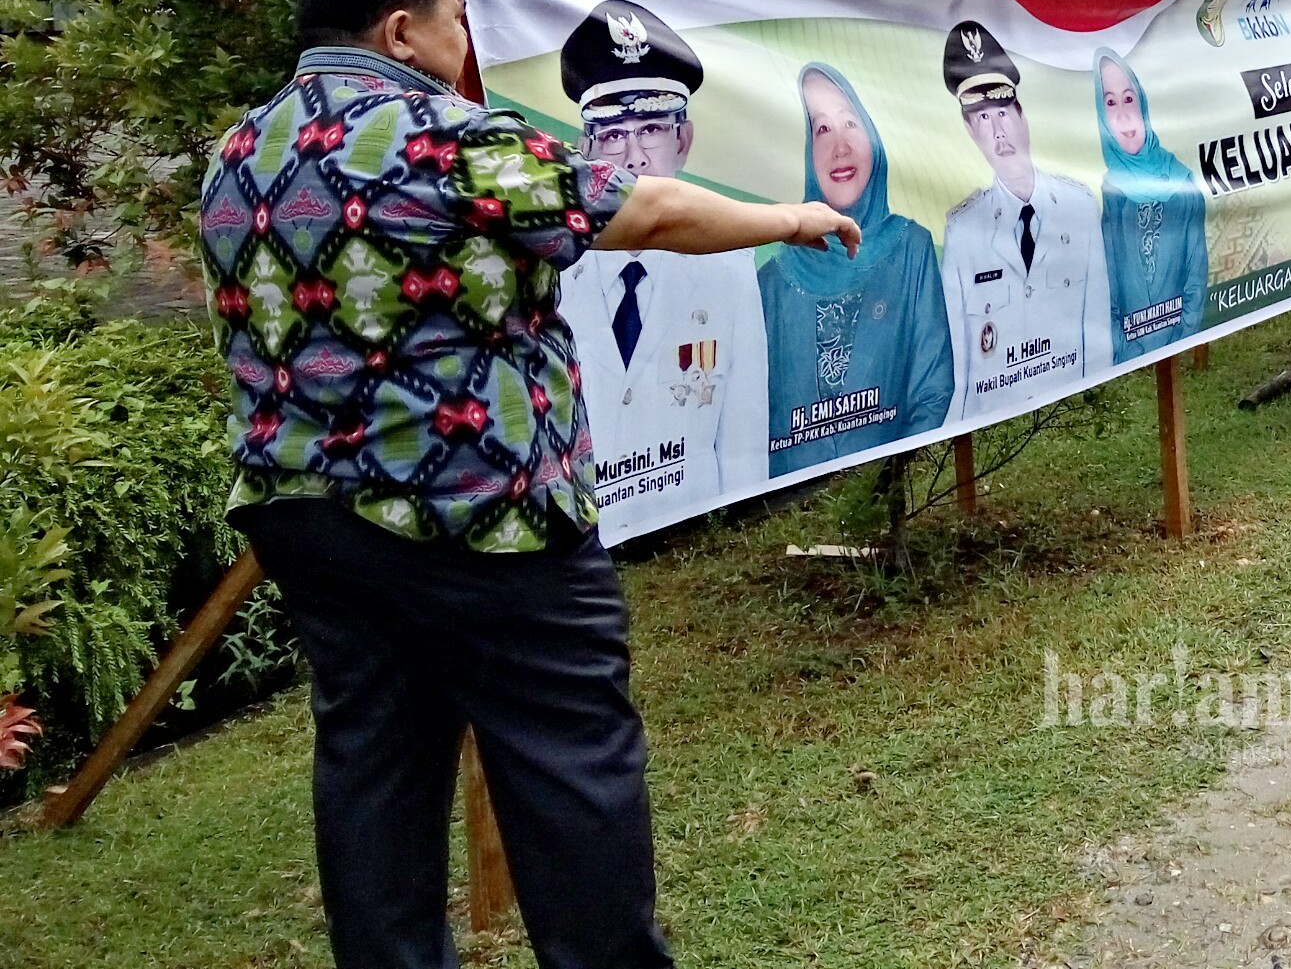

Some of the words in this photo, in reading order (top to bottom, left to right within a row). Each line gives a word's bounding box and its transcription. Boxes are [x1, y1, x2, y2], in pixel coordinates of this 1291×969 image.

[1165, 296, 1183, 314] HALIM
[976, 376, 998, 394] Wakil
[999, 368, 1022, 388] Bupati
[1023, 360, 1051, 380] Kuantan
[1051, 348, 1077, 369] Singingi
[1006, 345, 1018, 364] H.
[1021, 337, 1051, 359] Halim
[770, 437, 793, 452] Ketua
[820, 423, 836, 437] Kab.
[837, 414, 867, 433] Kuantan
[868, 406, 897, 425] Singingi
[792, 406, 809, 429] Hj.
[811, 399, 833, 423] EMI
[835, 387, 879, 416] SAFITRI
[595, 446, 655, 485] Mursini,
[660, 436, 685, 464] Msi
[596, 484, 635, 509] uantan
[638, 465, 685, 494] Singingi
